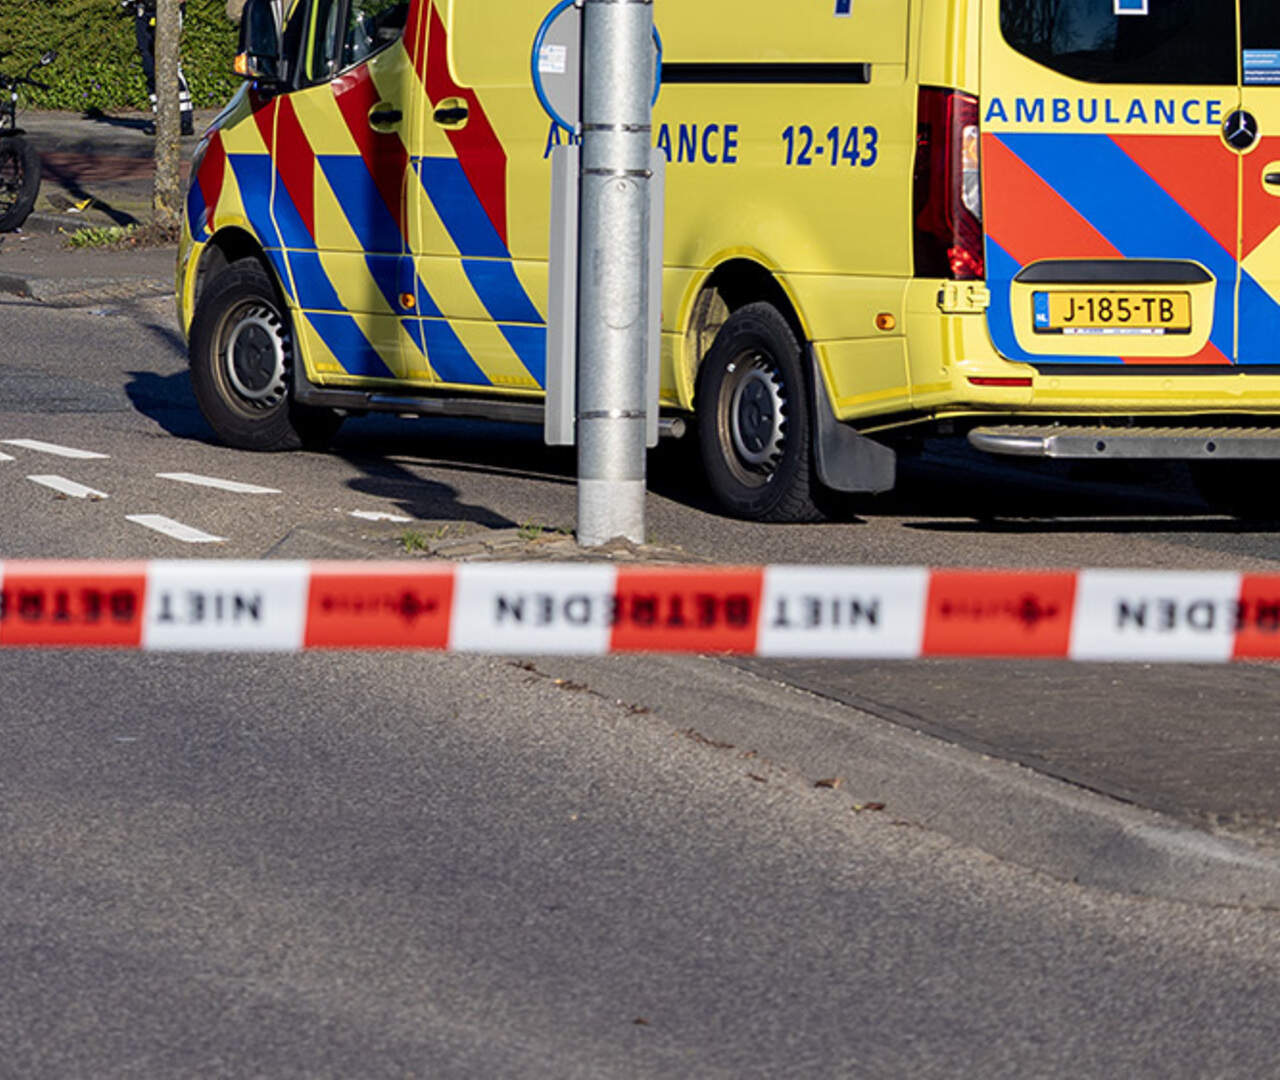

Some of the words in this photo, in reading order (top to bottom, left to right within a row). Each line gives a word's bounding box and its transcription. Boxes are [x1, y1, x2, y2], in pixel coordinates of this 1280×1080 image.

[984, 97, 1223, 125] AMBULANCE
[543, 122, 739, 164] AANCE
[781, 124, 880, 168] 12-143
[1063, 297, 1175, 323] J-185-TB
[156, 590, 264, 624] NIET
[772, 595, 883, 630] NIET
[1115, 597, 1280, 632] REDEN
